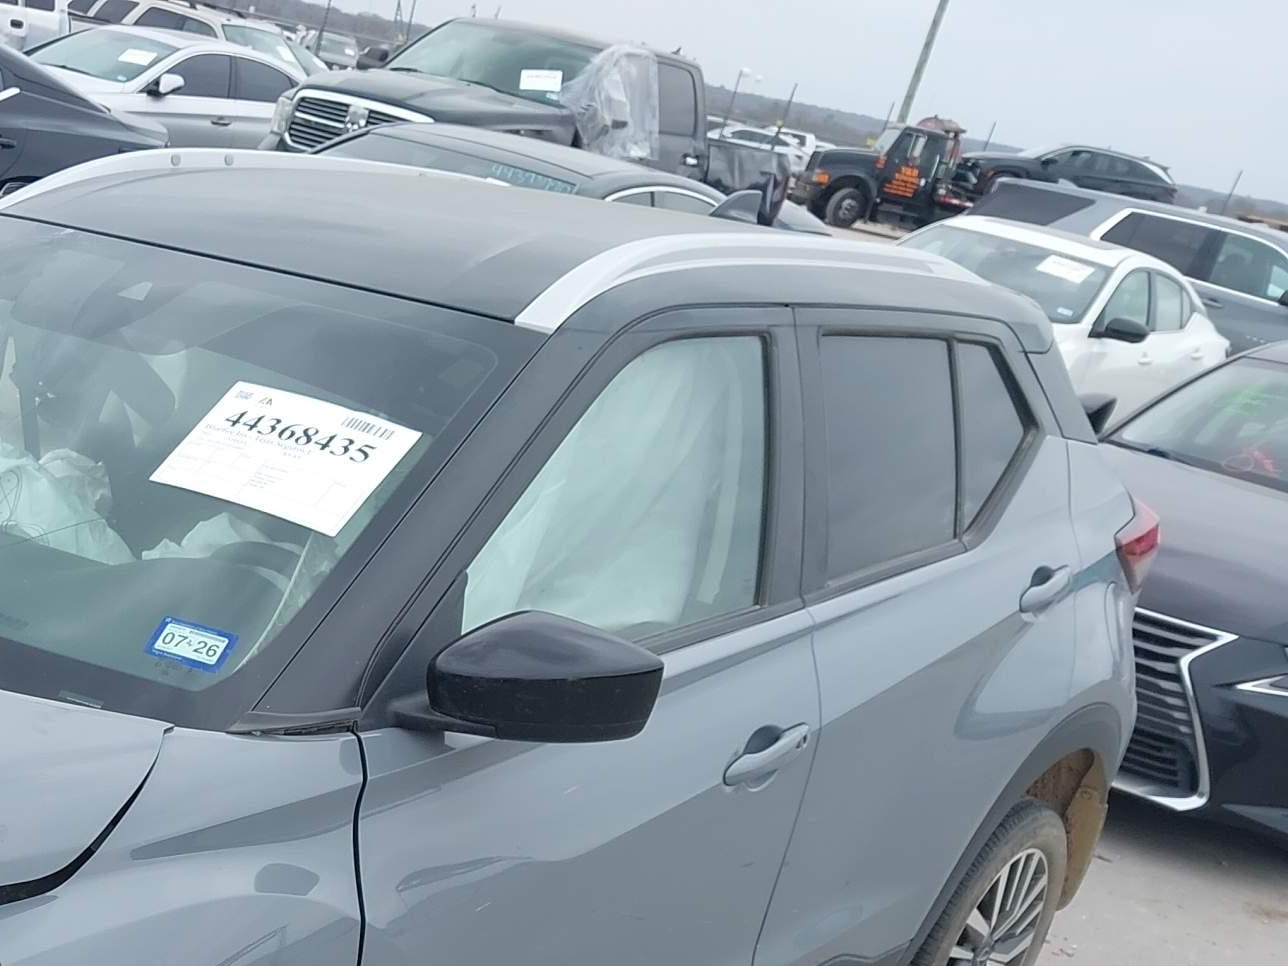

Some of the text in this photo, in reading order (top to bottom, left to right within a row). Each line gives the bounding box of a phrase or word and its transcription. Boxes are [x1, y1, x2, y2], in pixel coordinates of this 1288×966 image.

[224, 410, 377, 463] 44368435
[162, 632, 188, 648] 07
[192, 641, 220, 658] 26
